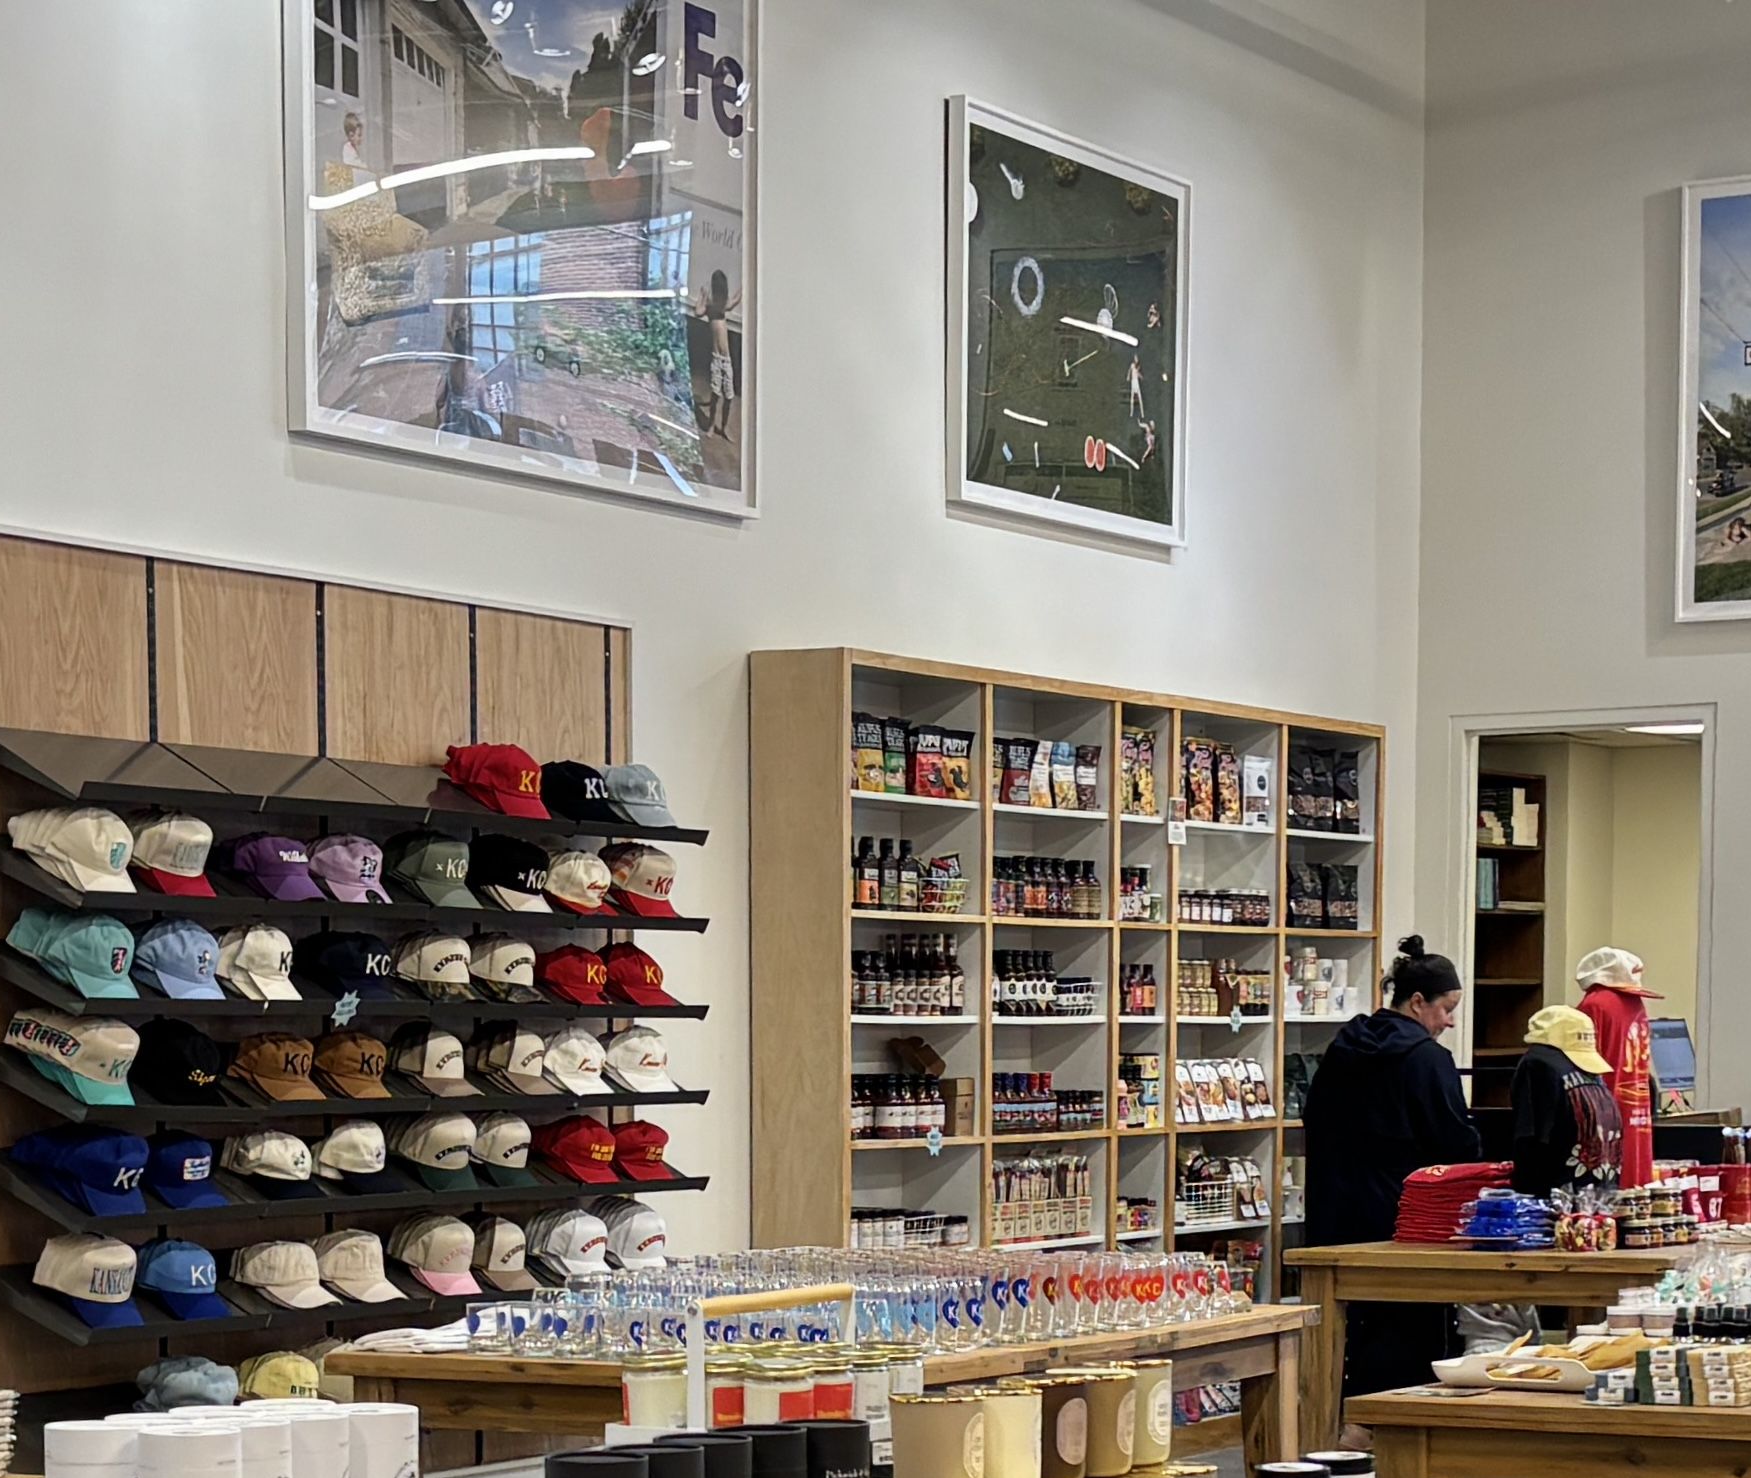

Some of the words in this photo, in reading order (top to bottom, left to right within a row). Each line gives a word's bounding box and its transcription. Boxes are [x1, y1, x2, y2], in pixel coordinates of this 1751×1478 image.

[446, 858, 467, 879] KC
[526, 869, 547, 890] KC
[365, 953, 393, 976] KC
[283, 1051, 311, 1076] KC
[359, 1051, 385, 1076] KC
[190, 1264, 217, 1287] KC
